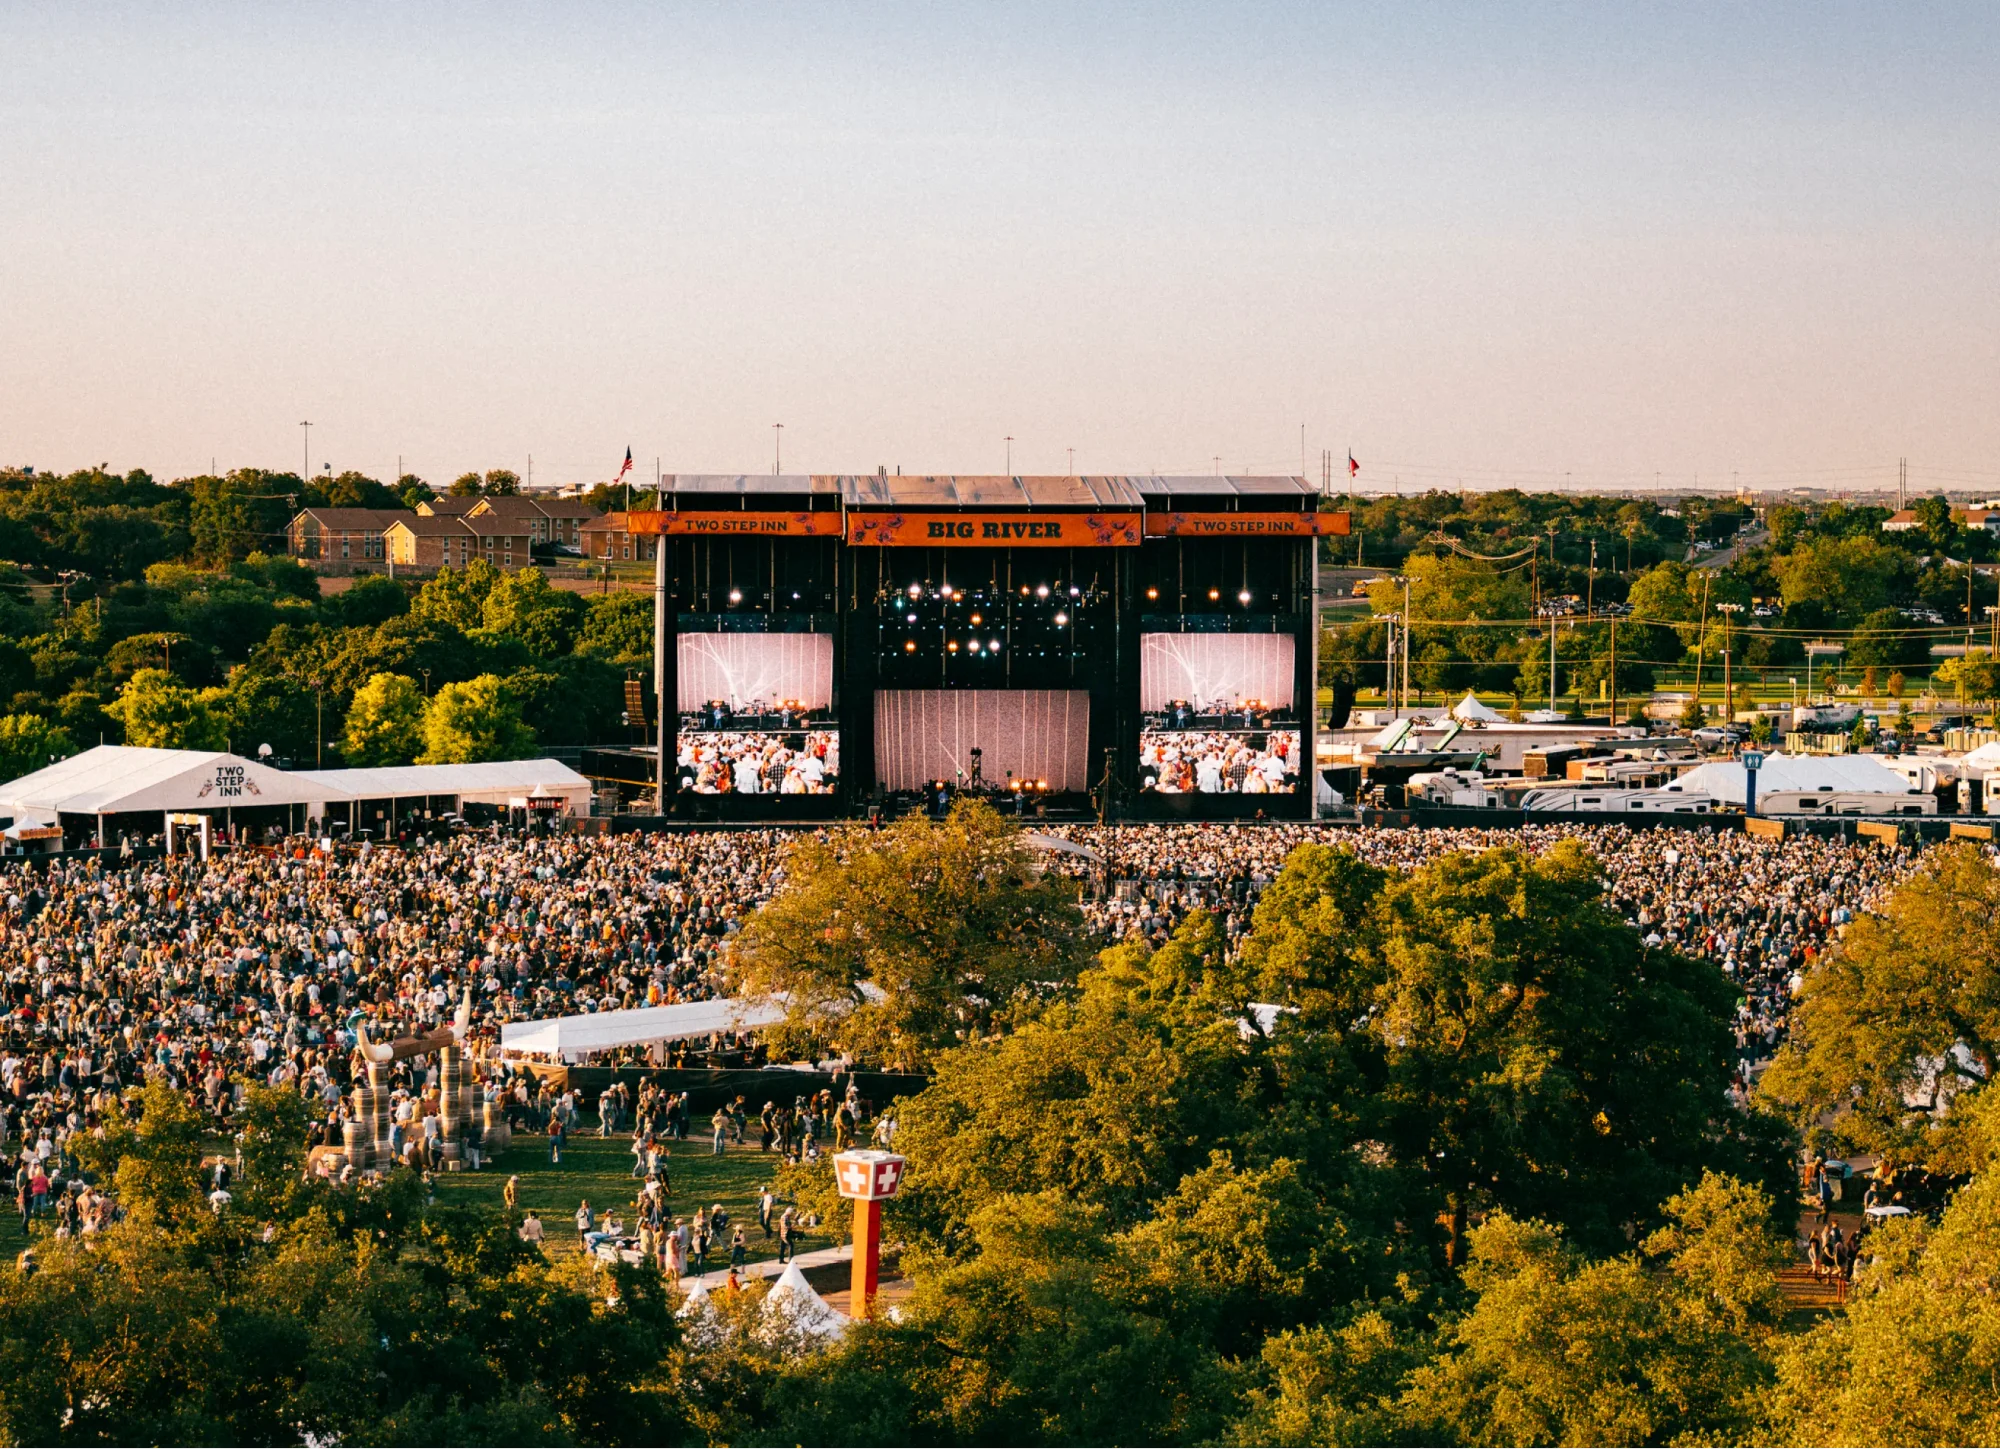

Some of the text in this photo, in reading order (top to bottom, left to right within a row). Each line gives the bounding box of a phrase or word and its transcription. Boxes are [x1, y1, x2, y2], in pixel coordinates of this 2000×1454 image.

[685, 520, 787, 531] TWO STEP INN
[928, 522, 1062, 538] BIG RIVER
[1194, 521, 1294, 531] TWO STEP INN
[216, 766, 244, 776] TWO
[215, 776, 244, 786] STEP
[220, 787, 242, 797] INN
